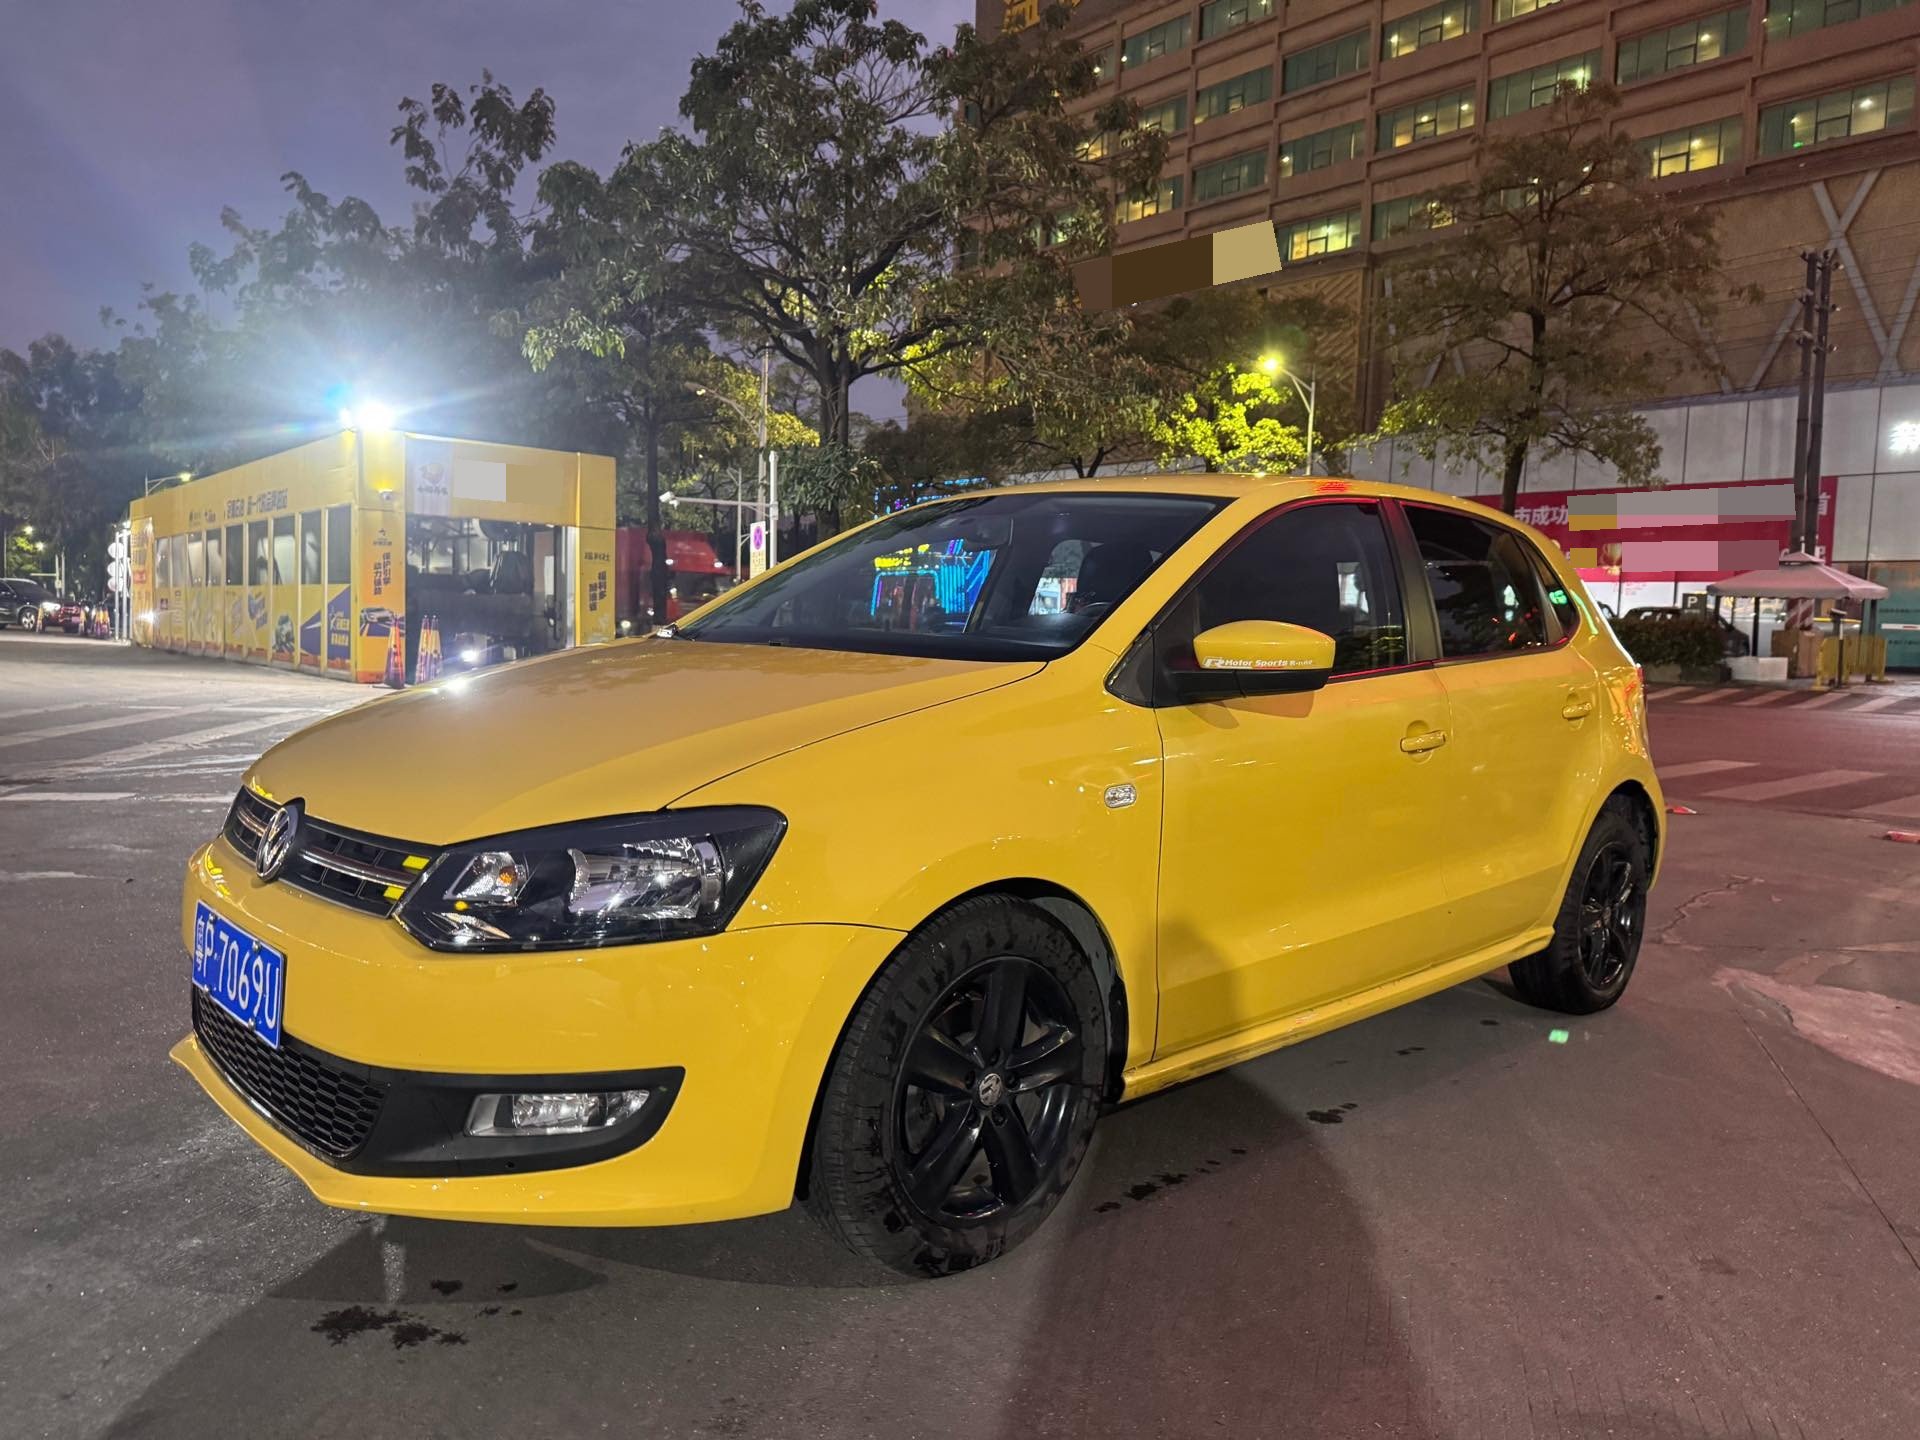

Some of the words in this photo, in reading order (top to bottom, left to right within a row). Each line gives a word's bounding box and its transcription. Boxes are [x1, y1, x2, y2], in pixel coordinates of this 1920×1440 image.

[1687, 596, 1698, 608] P
[1224, 659, 1252, 667] Motor
[1255, 659, 1288, 667] Sports
